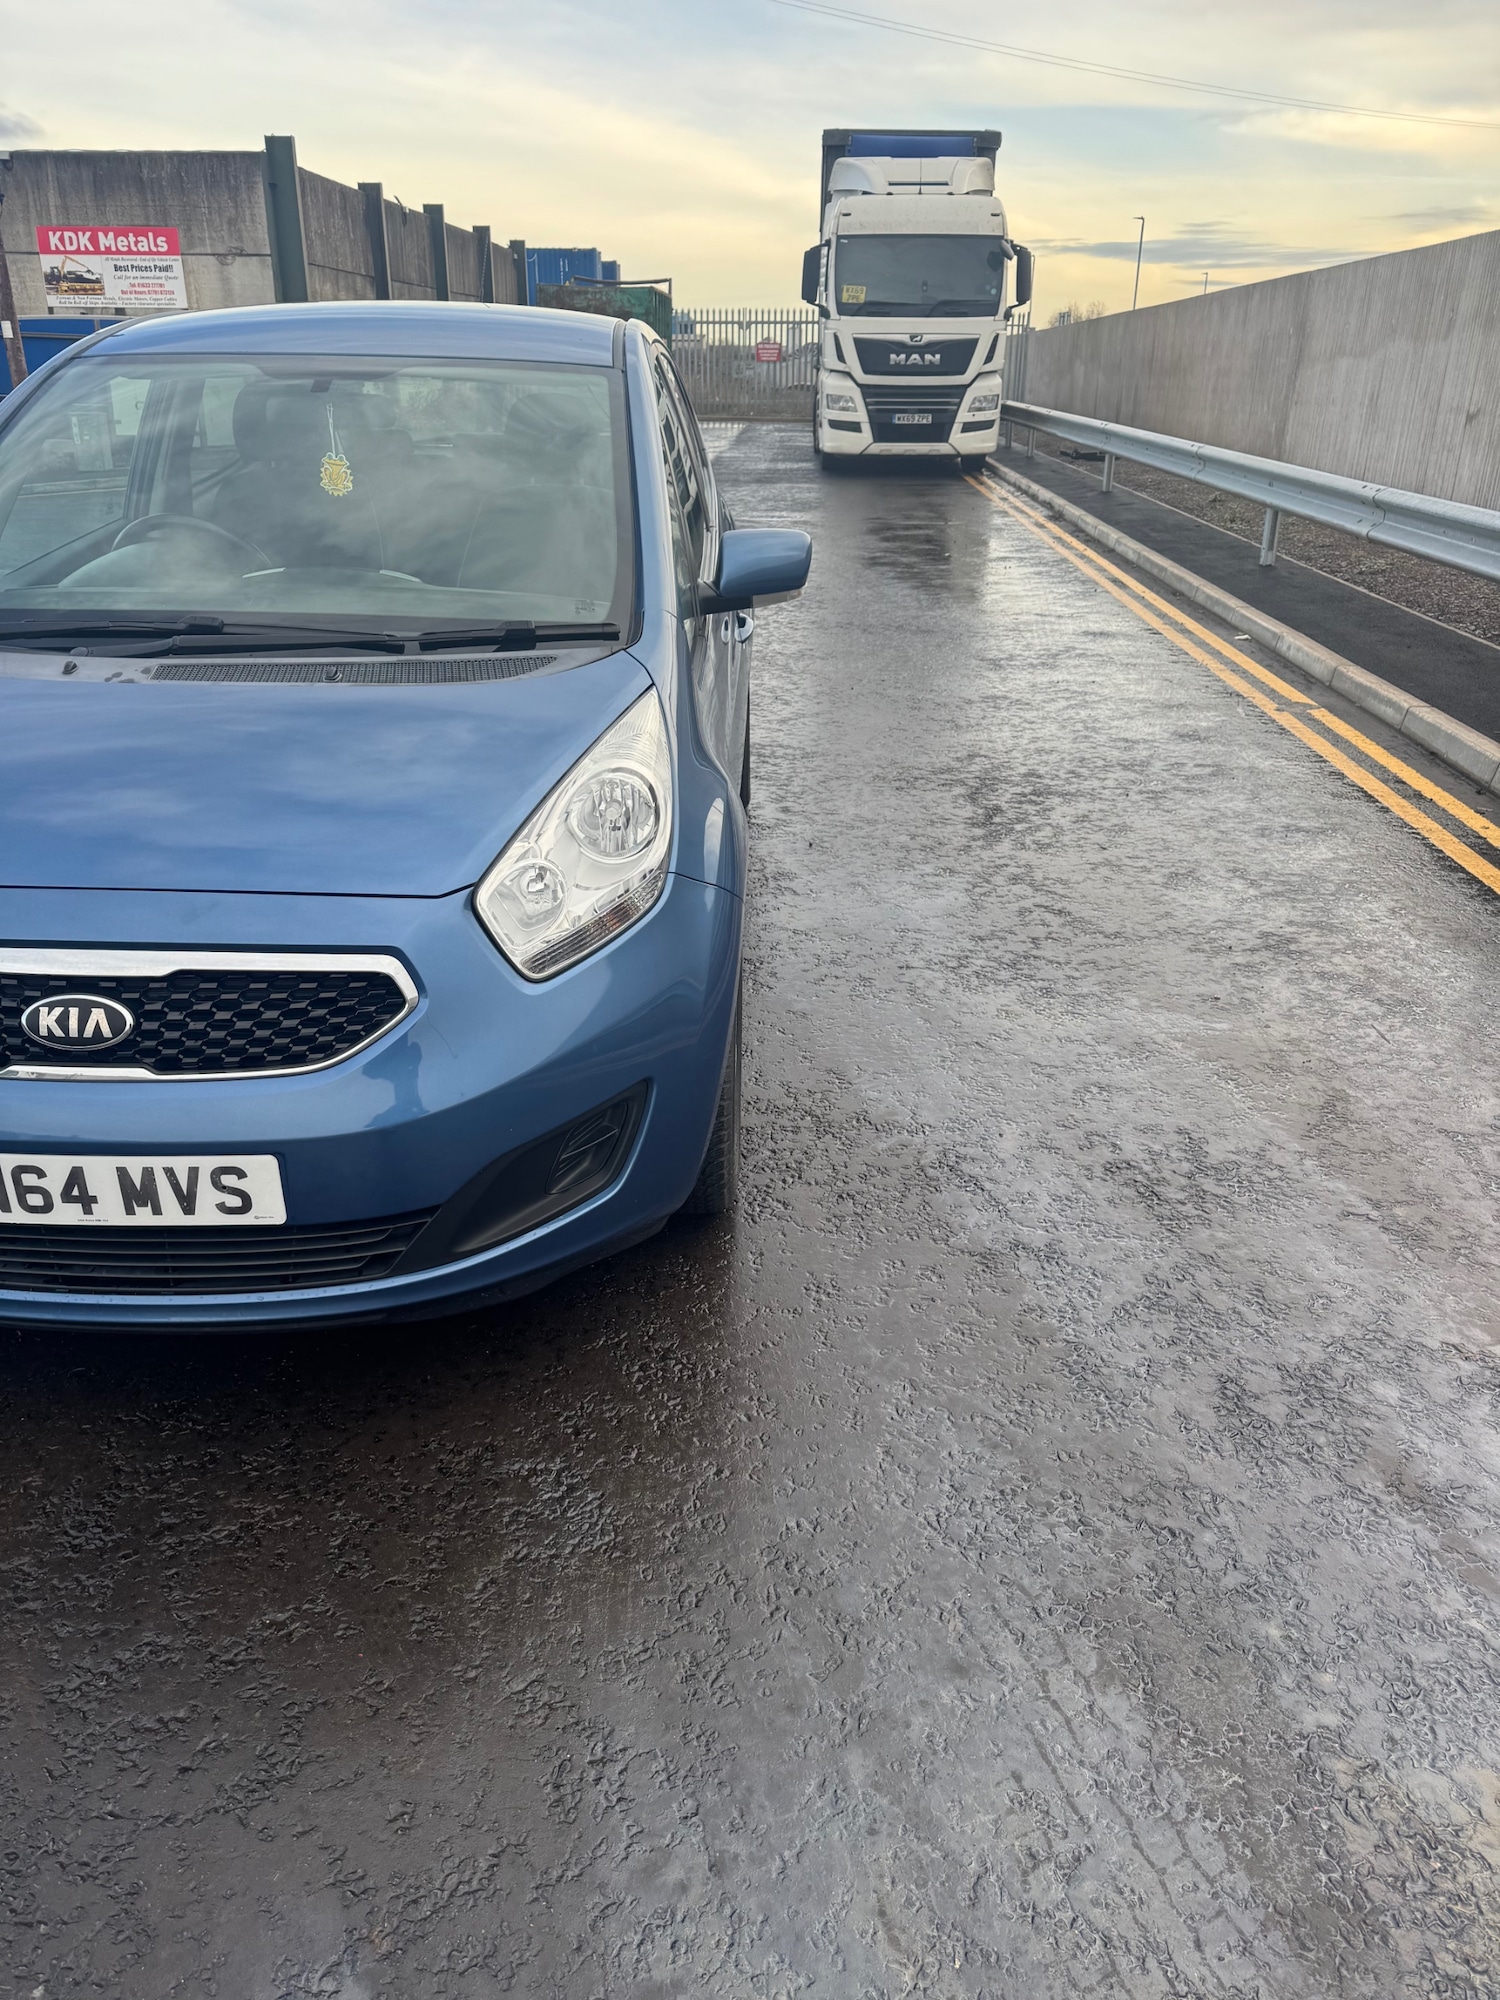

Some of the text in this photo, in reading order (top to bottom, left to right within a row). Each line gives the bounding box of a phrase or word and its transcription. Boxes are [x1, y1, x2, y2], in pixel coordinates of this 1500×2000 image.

[48, 230, 168, 252] KDK Metals
[114, 264, 174, 273] Best Prices Paid!!
[889, 353, 941, 365] MAN
[38, 1006, 114, 1038] KIA
[115, 1166, 253, 1216] MVS
